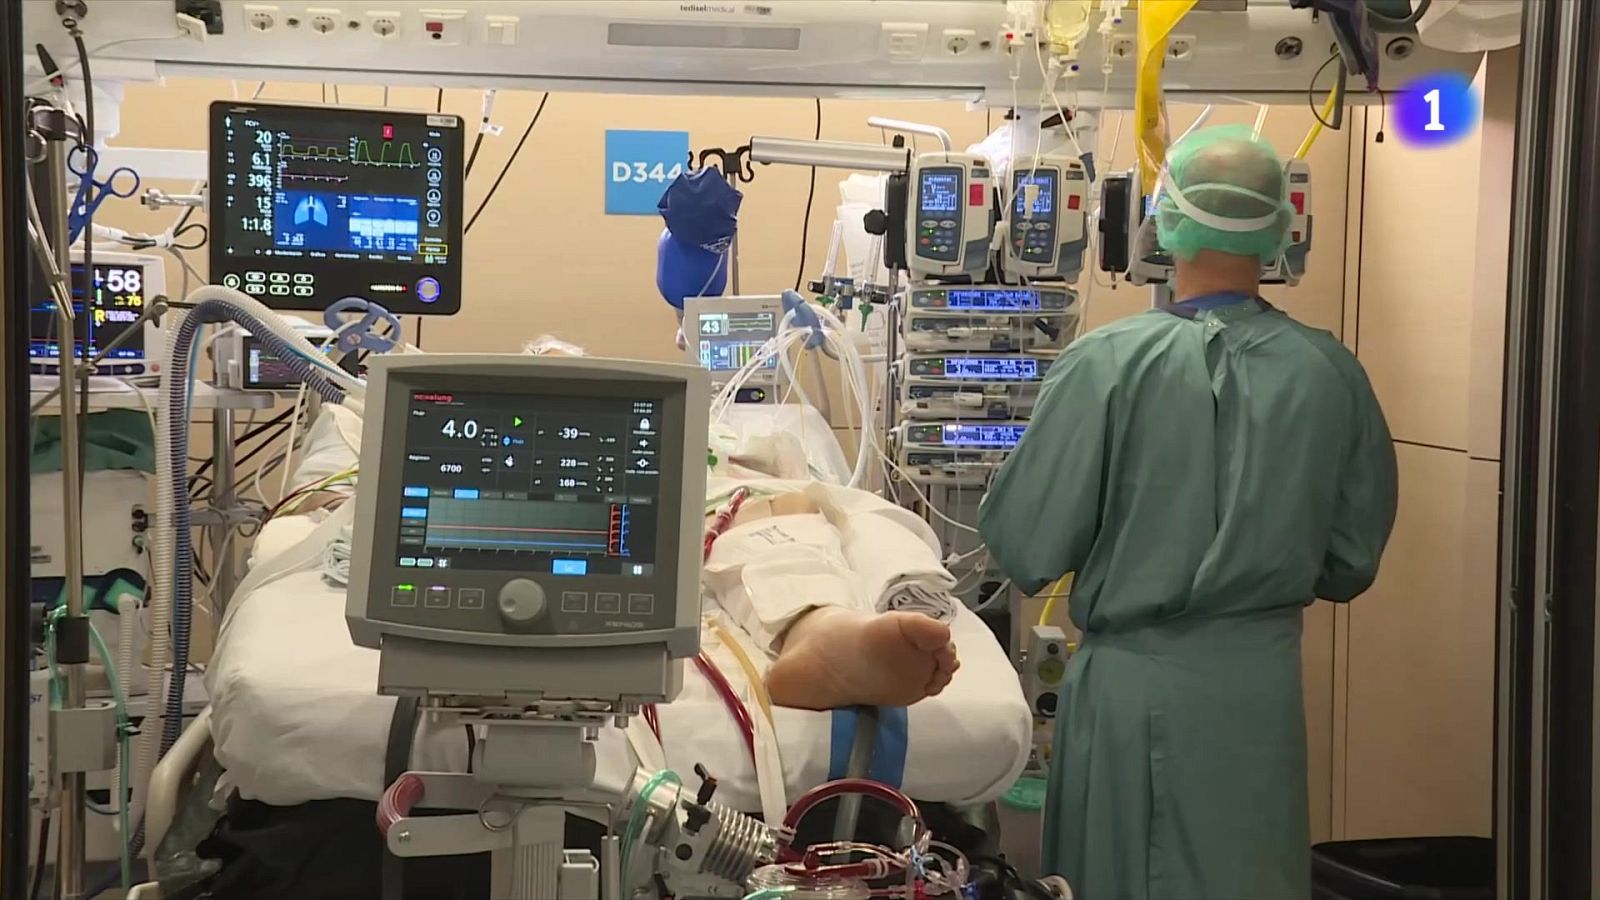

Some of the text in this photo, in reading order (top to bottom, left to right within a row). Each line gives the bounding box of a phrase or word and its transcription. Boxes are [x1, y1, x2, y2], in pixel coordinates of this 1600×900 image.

[255, 130, 273, 144] 20
[252, 152, 270, 166] 6.1
[248, 174, 272, 187] 396
[256, 196, 272, 209] 15
[242, 217, 272, 231] 1:1.8
[107, 269, 141, 292] 58
[702, 320, 720, 333] 43
[442, 419, 478, 438] 4.0
[558, 427, 579, 439] -39
[440, 464, 462, 473] 6700
